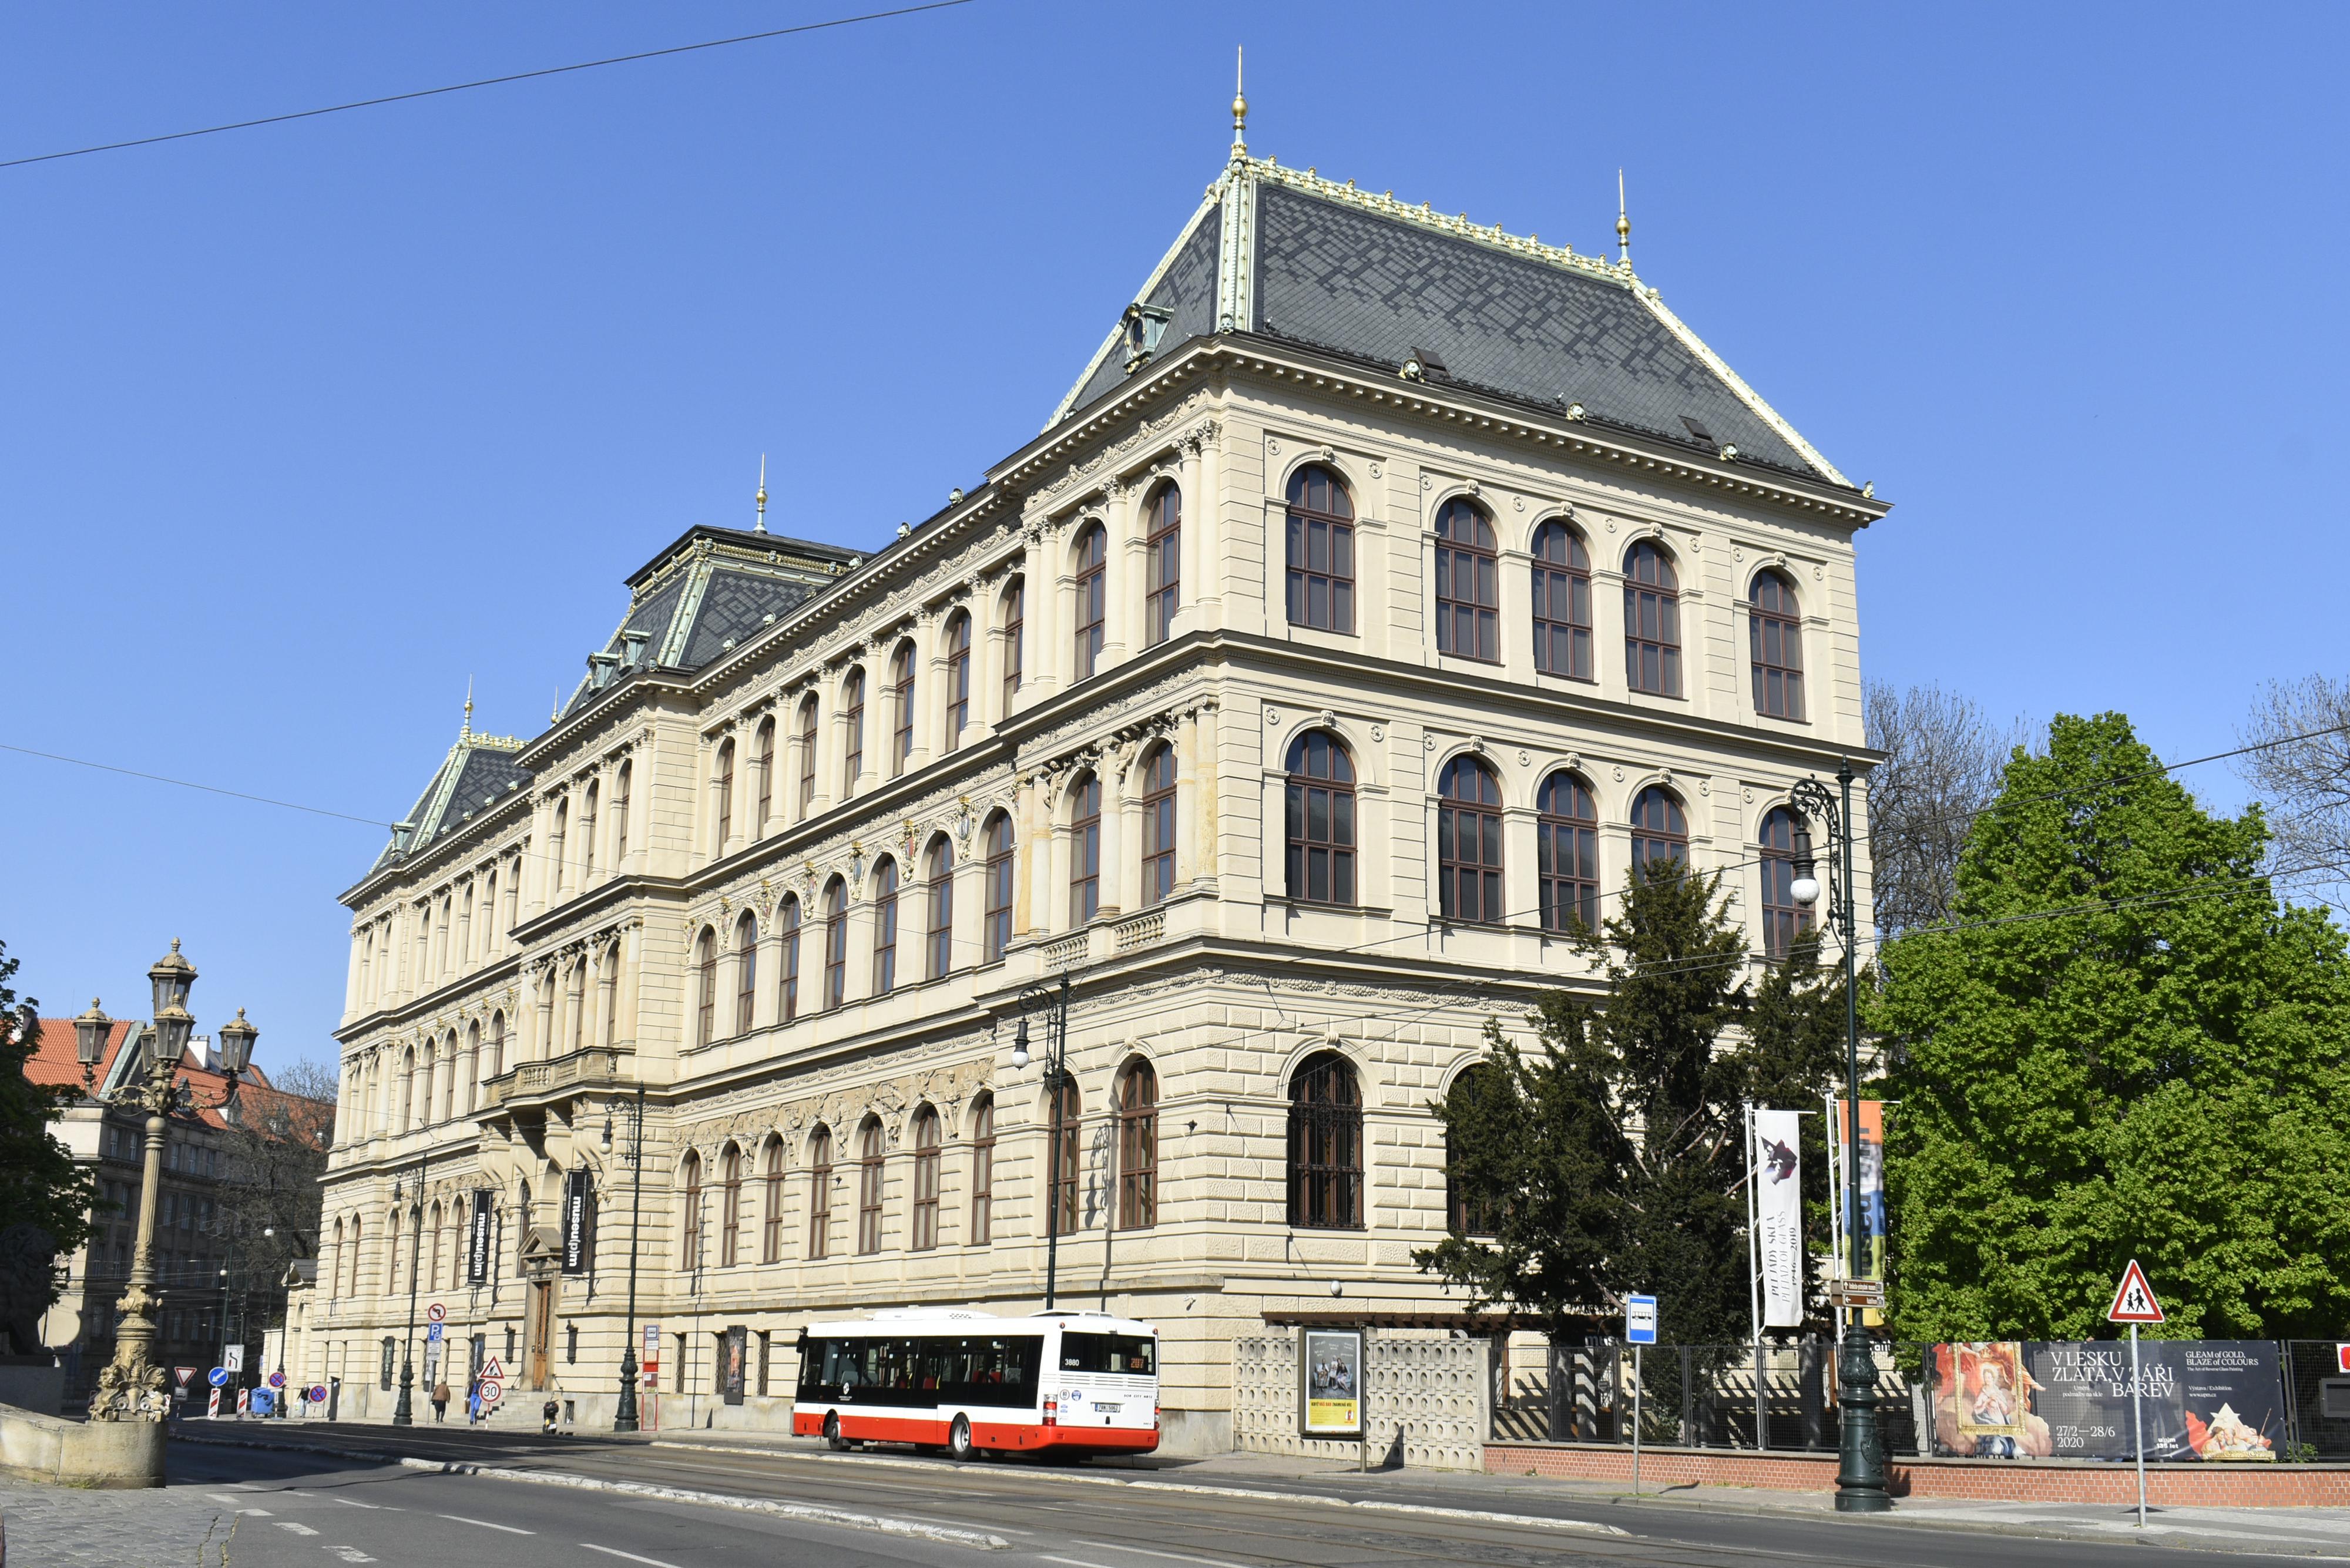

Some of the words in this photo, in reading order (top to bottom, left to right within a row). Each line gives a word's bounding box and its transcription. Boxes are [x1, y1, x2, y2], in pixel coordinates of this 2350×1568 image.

[568, 1196, 581, 1267] museu(p)m
[474, 1213, 486, 1277] museu(p)m
[431, 1325, 439, 1336] P
[1065, 1358, 1080, 1366] 3880
[2050, 1352, 2062, 1366] V
[2066, 1352, 2121, 1366] LESKU
[484, 1386, 497, 1397] 30
[2113, 1382, 2174, 1397] BAREV
[2057, 1437, 2084, 1448] 2020
